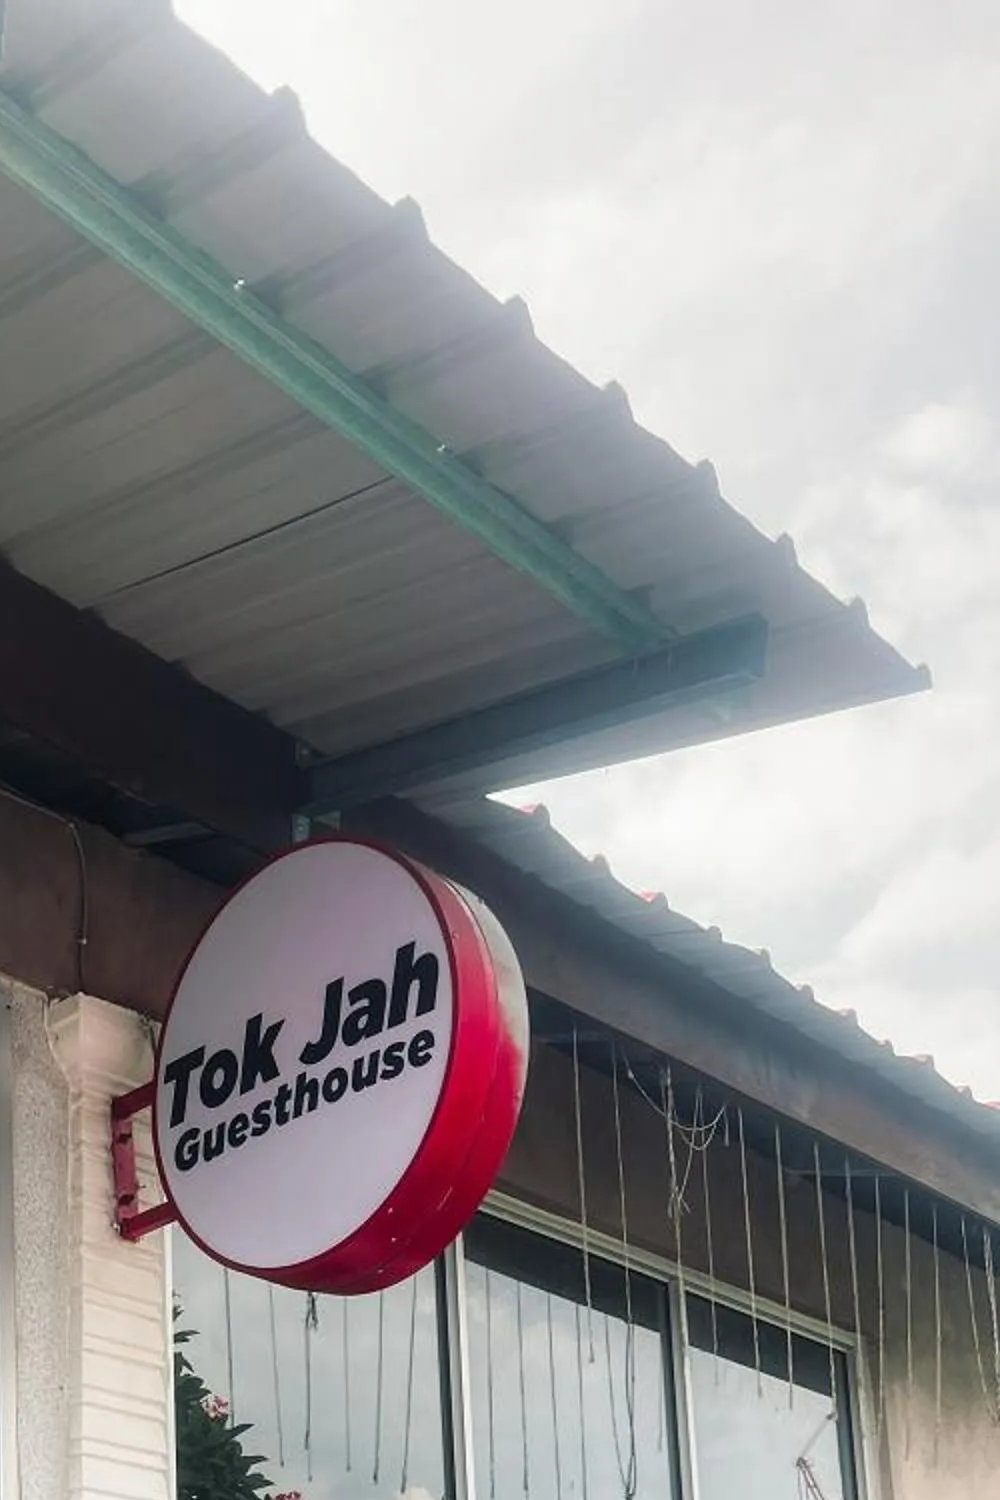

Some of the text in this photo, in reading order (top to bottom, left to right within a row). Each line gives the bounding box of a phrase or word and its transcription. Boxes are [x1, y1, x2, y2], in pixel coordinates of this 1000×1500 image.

[164, 941, 439, 1128] Tok Jah
[174, 1029, 435, 1172] Guesthouse
